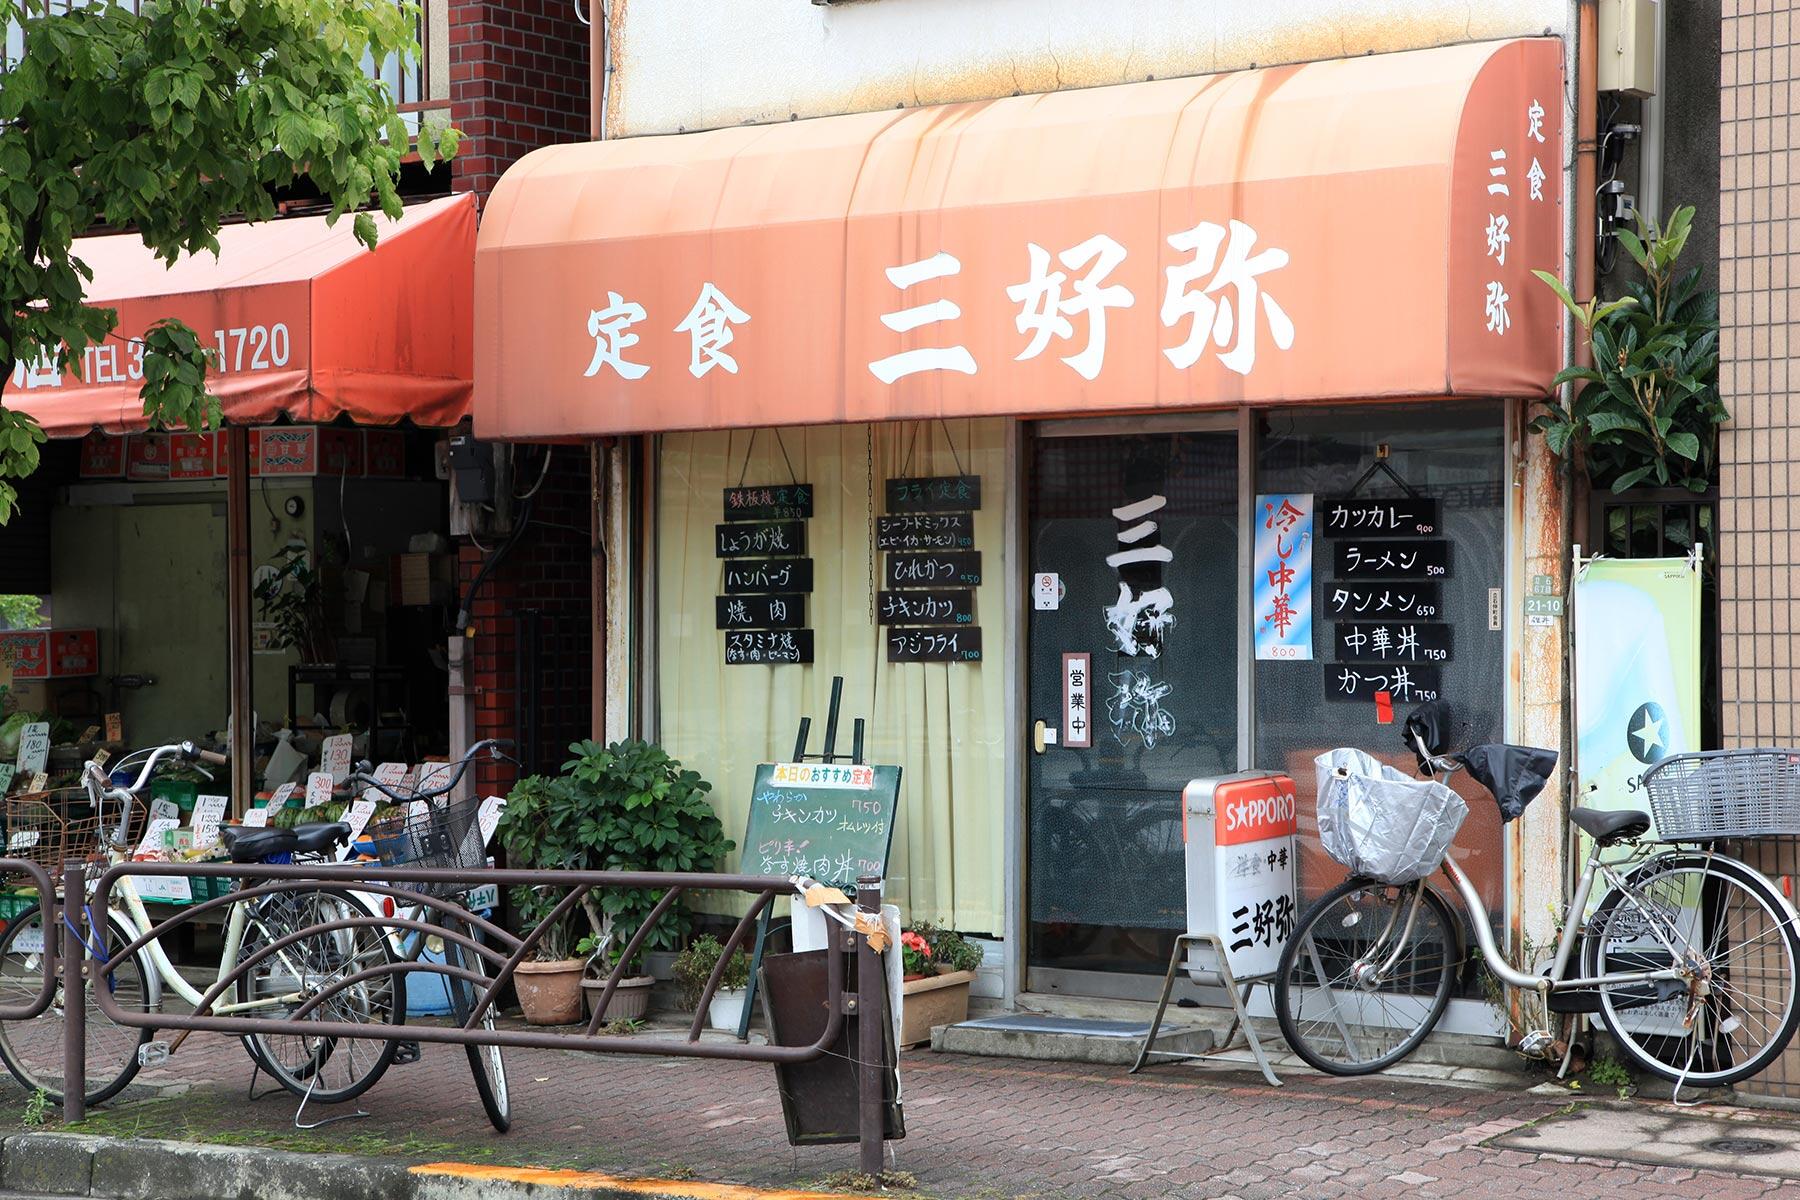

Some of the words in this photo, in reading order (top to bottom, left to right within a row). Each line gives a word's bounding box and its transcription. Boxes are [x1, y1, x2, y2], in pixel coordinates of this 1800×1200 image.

[1525, 98, 1546, 202] 定食
[1484, 148, 1512, 336] 三好弥
[582, 281, 752, 379] 定食
[868, 217, 1296, 386] 三好弥
[84, 344, 127, 385] TEL
[729, 486, 810, 508] 鉄板焼定食
[896, 479, 972, 501] フライ定食
[880, 516, 962, 533] シーフードミックス
[1329, 504, 1414, 530] カツカレー
[1416, 522, 1434, 534] 900
[719, 526, 790, 553] しょうが焼
[727, 562, 791, 587] ハンバーグ
[894, 558, 955, 580] ひれかつ
[1264, 498, 1305, 639] 冷し中華
[1346, 547, 1417, 572] ラーメン
[1426, 564, 1446, 576] 500
[727, 600, 788, 624] 焼肉
[882, 595, 954, 618] チキンカツ
[955, 613, 973, 623] 800
[1332, 590, 1416, 612] タンメン
[1415, 606, 1436, 617] 650
[1527, 599, 1561, 613] 21-10
[729, 631, 797, 651] スタミナ焼
[890, 631, 959, 655] アジフライ
[960, 649, 980, 661] 700
[1270, 646, 1297, 658] 800
[1343, 626, 1420, 661] 中華丼
[1424, 648, 1447, 660] 750
[1337, 665, 1416, 702] かつ丼
[1414, 689, 1437, 701] 750
[1069, 669, 1086, 735] 営業中
[774, 766, 873, 786] 本日のおすすめ定食
[756, 790, 808, 804] やわらか
[851, 799, 881, 815] 750
[772, 804, 838, 824] チキンカツ
[858, 859, 881, 872] 700
[1230, 894, 1296, 953] 三好弥
